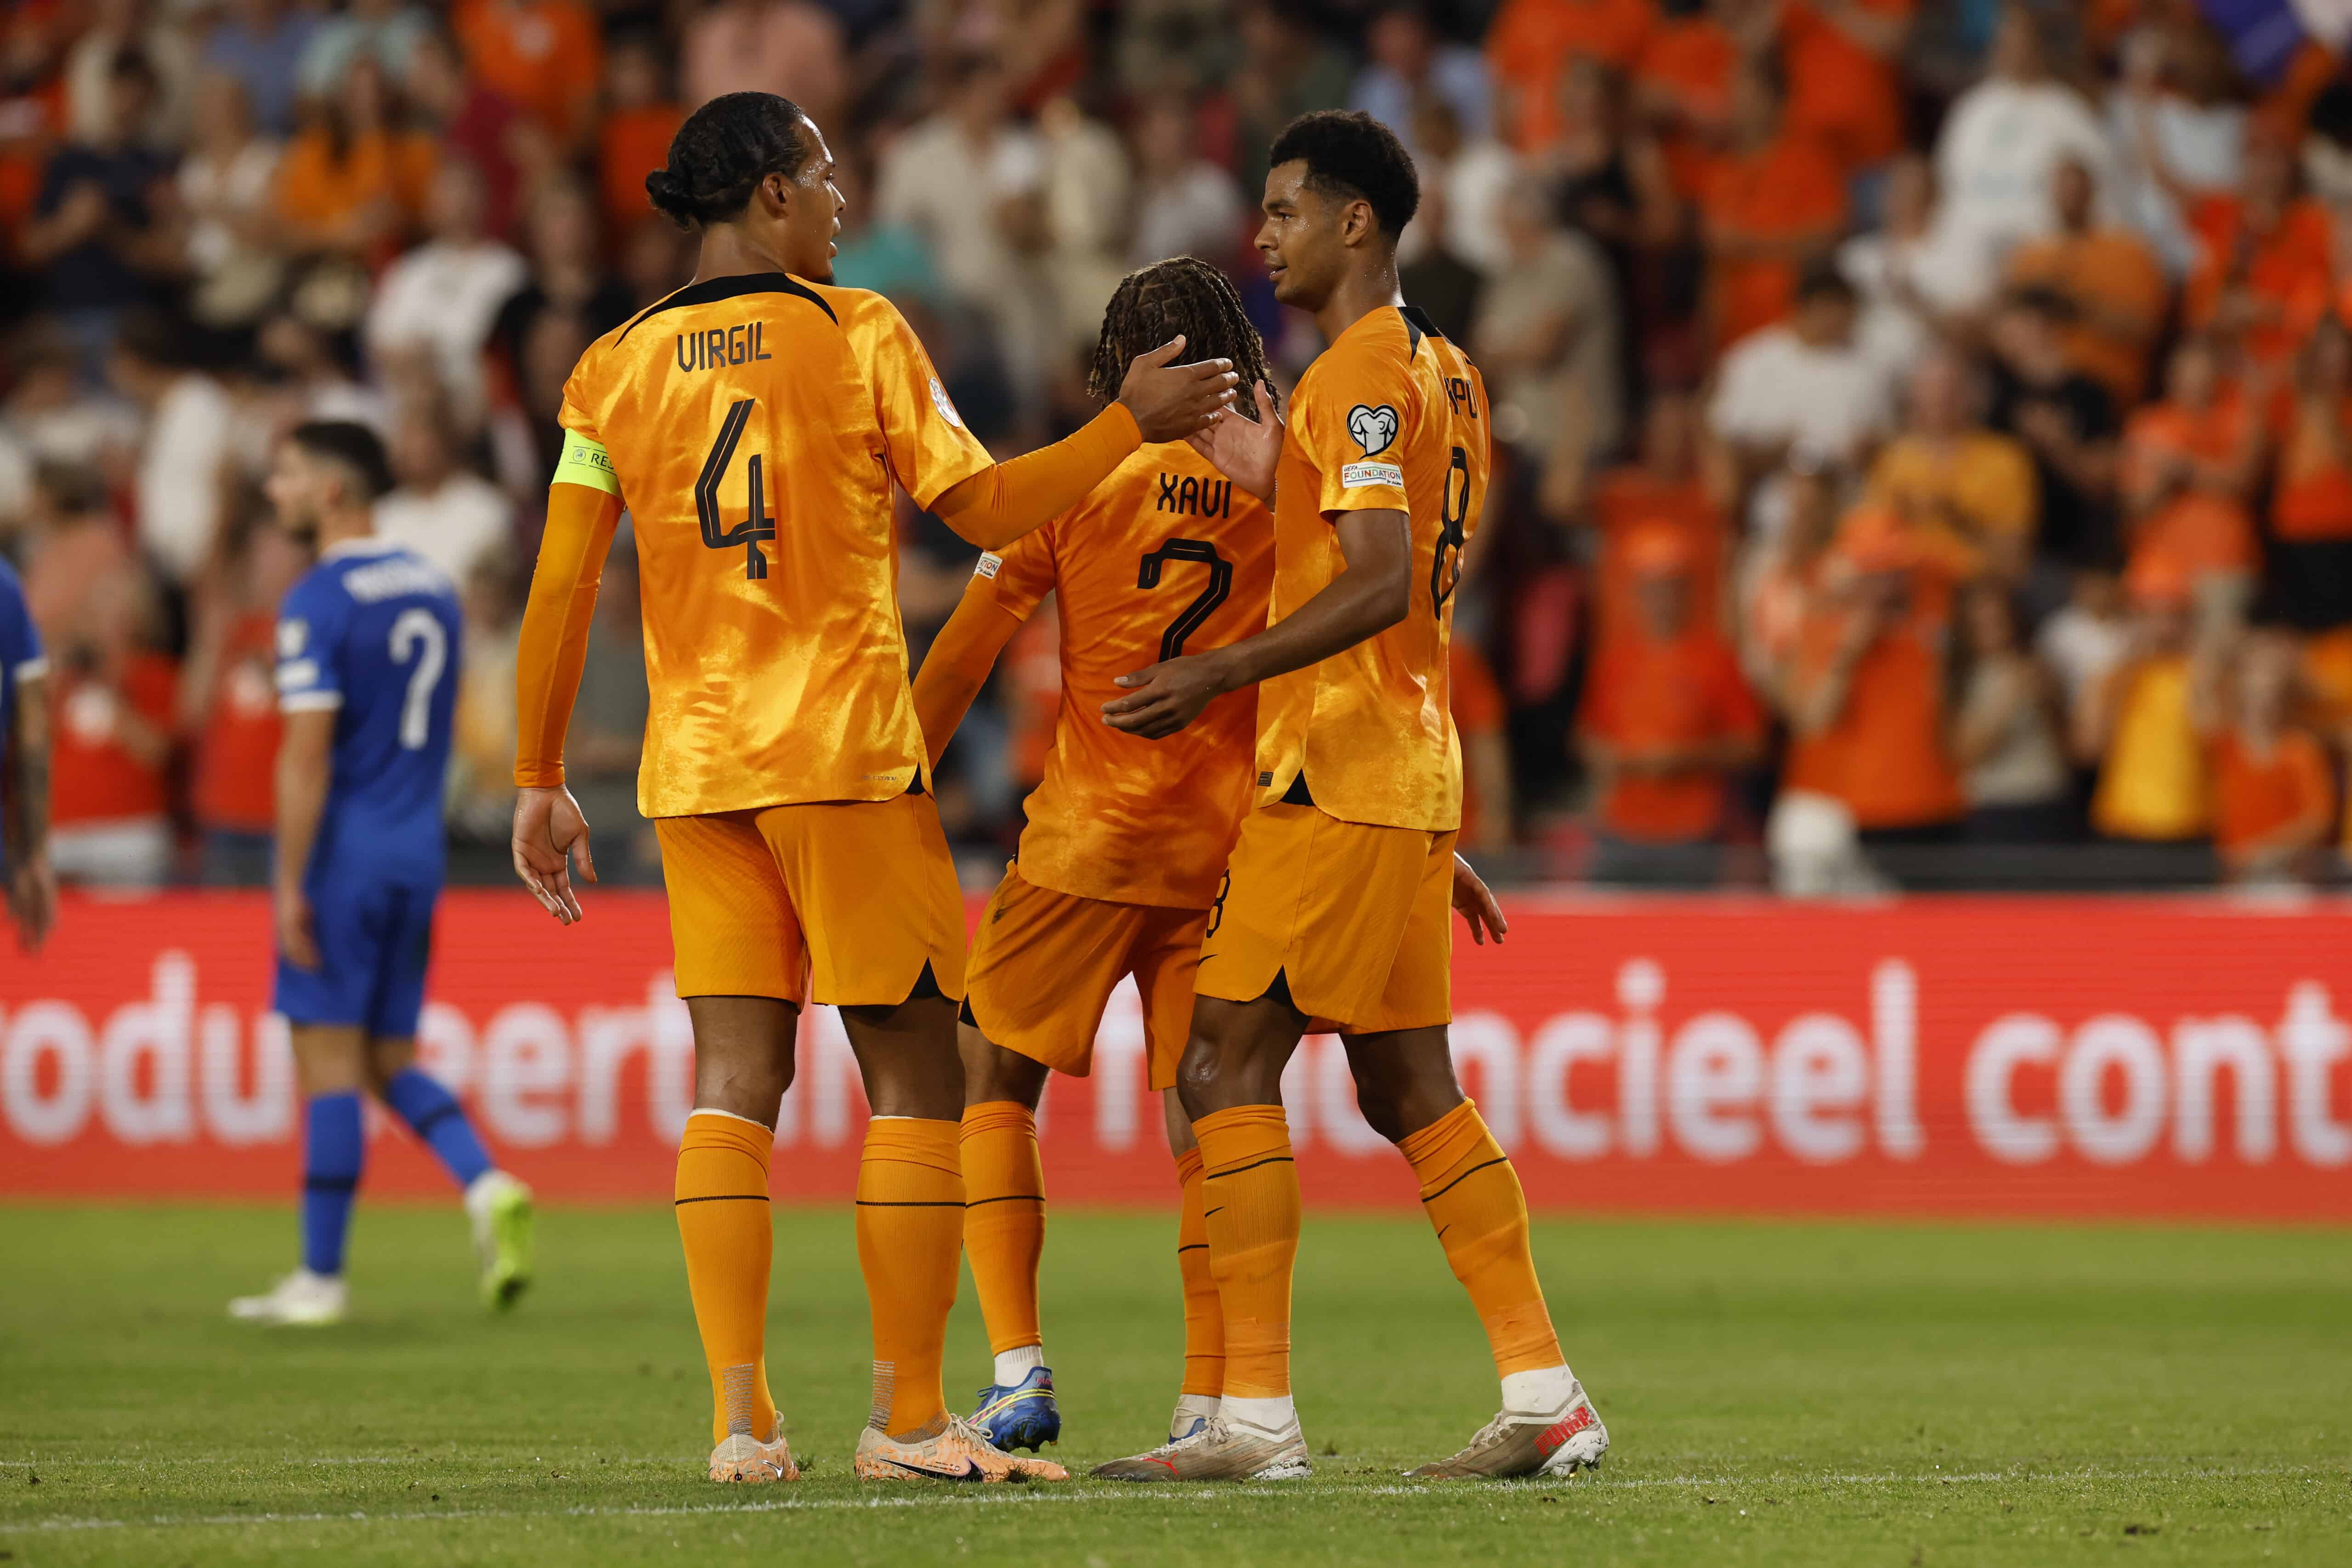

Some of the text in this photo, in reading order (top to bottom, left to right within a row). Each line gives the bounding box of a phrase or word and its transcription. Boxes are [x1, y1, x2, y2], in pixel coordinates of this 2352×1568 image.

[678, 322, 771, 372] VIRGIL
[695, 398, 776, 579] 4
[1157, 472, 1232, 519] XAVI
[1344, 469, 1401, 480] FOUNDATION
[1430, 446, 1470, 621] 8
[1533, 1405, 1594, 1456] PUMA
